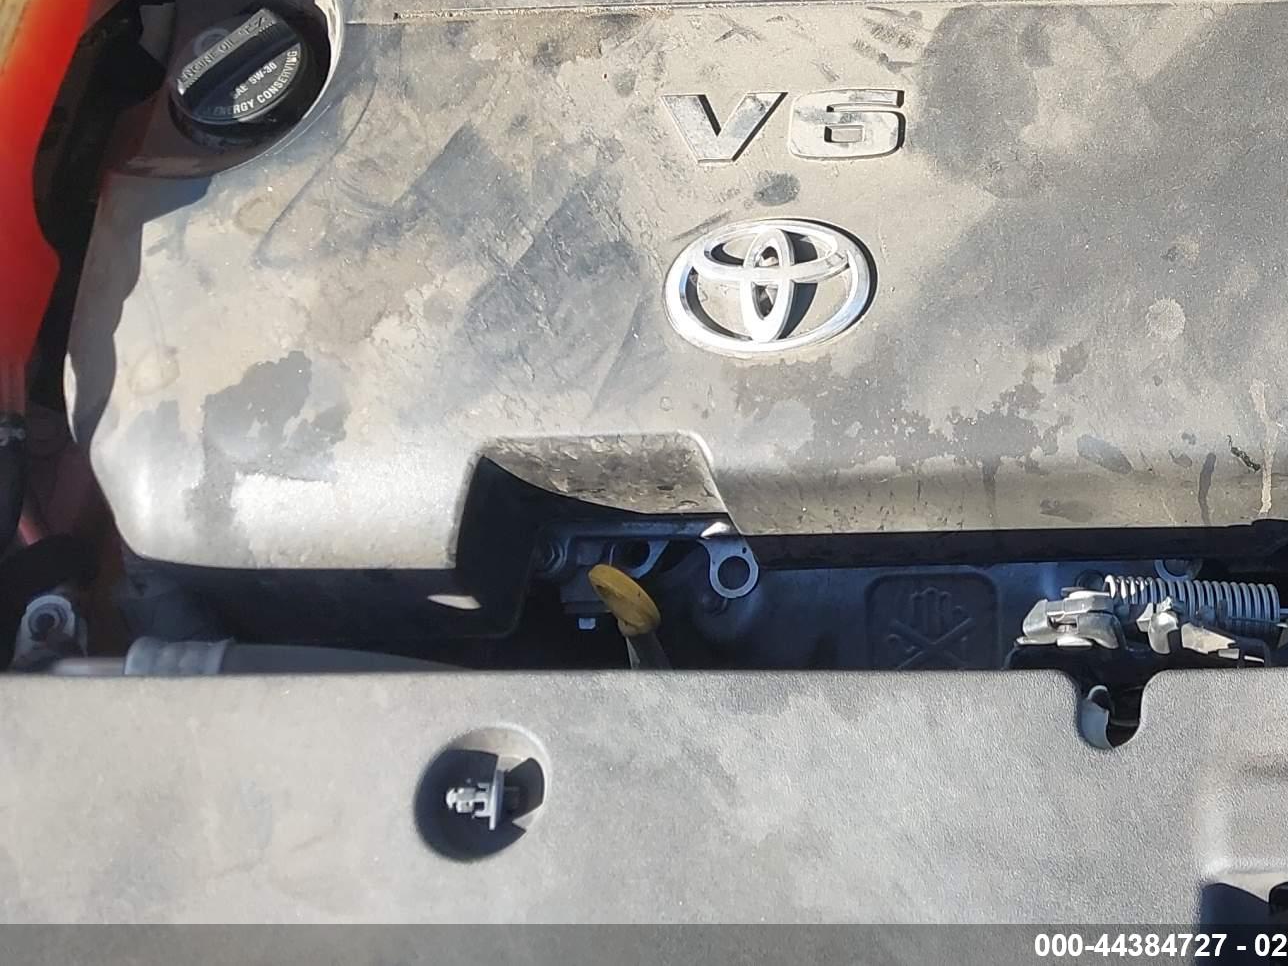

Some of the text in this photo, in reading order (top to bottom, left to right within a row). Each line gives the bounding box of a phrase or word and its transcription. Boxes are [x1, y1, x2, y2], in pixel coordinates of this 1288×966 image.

[181, 53, 217, 83] ENGINE
[248, 62, 278, 85] 5W-30
[257, 51, 298, 104] CONSERVING
[660, 89, 906, 162] V6
